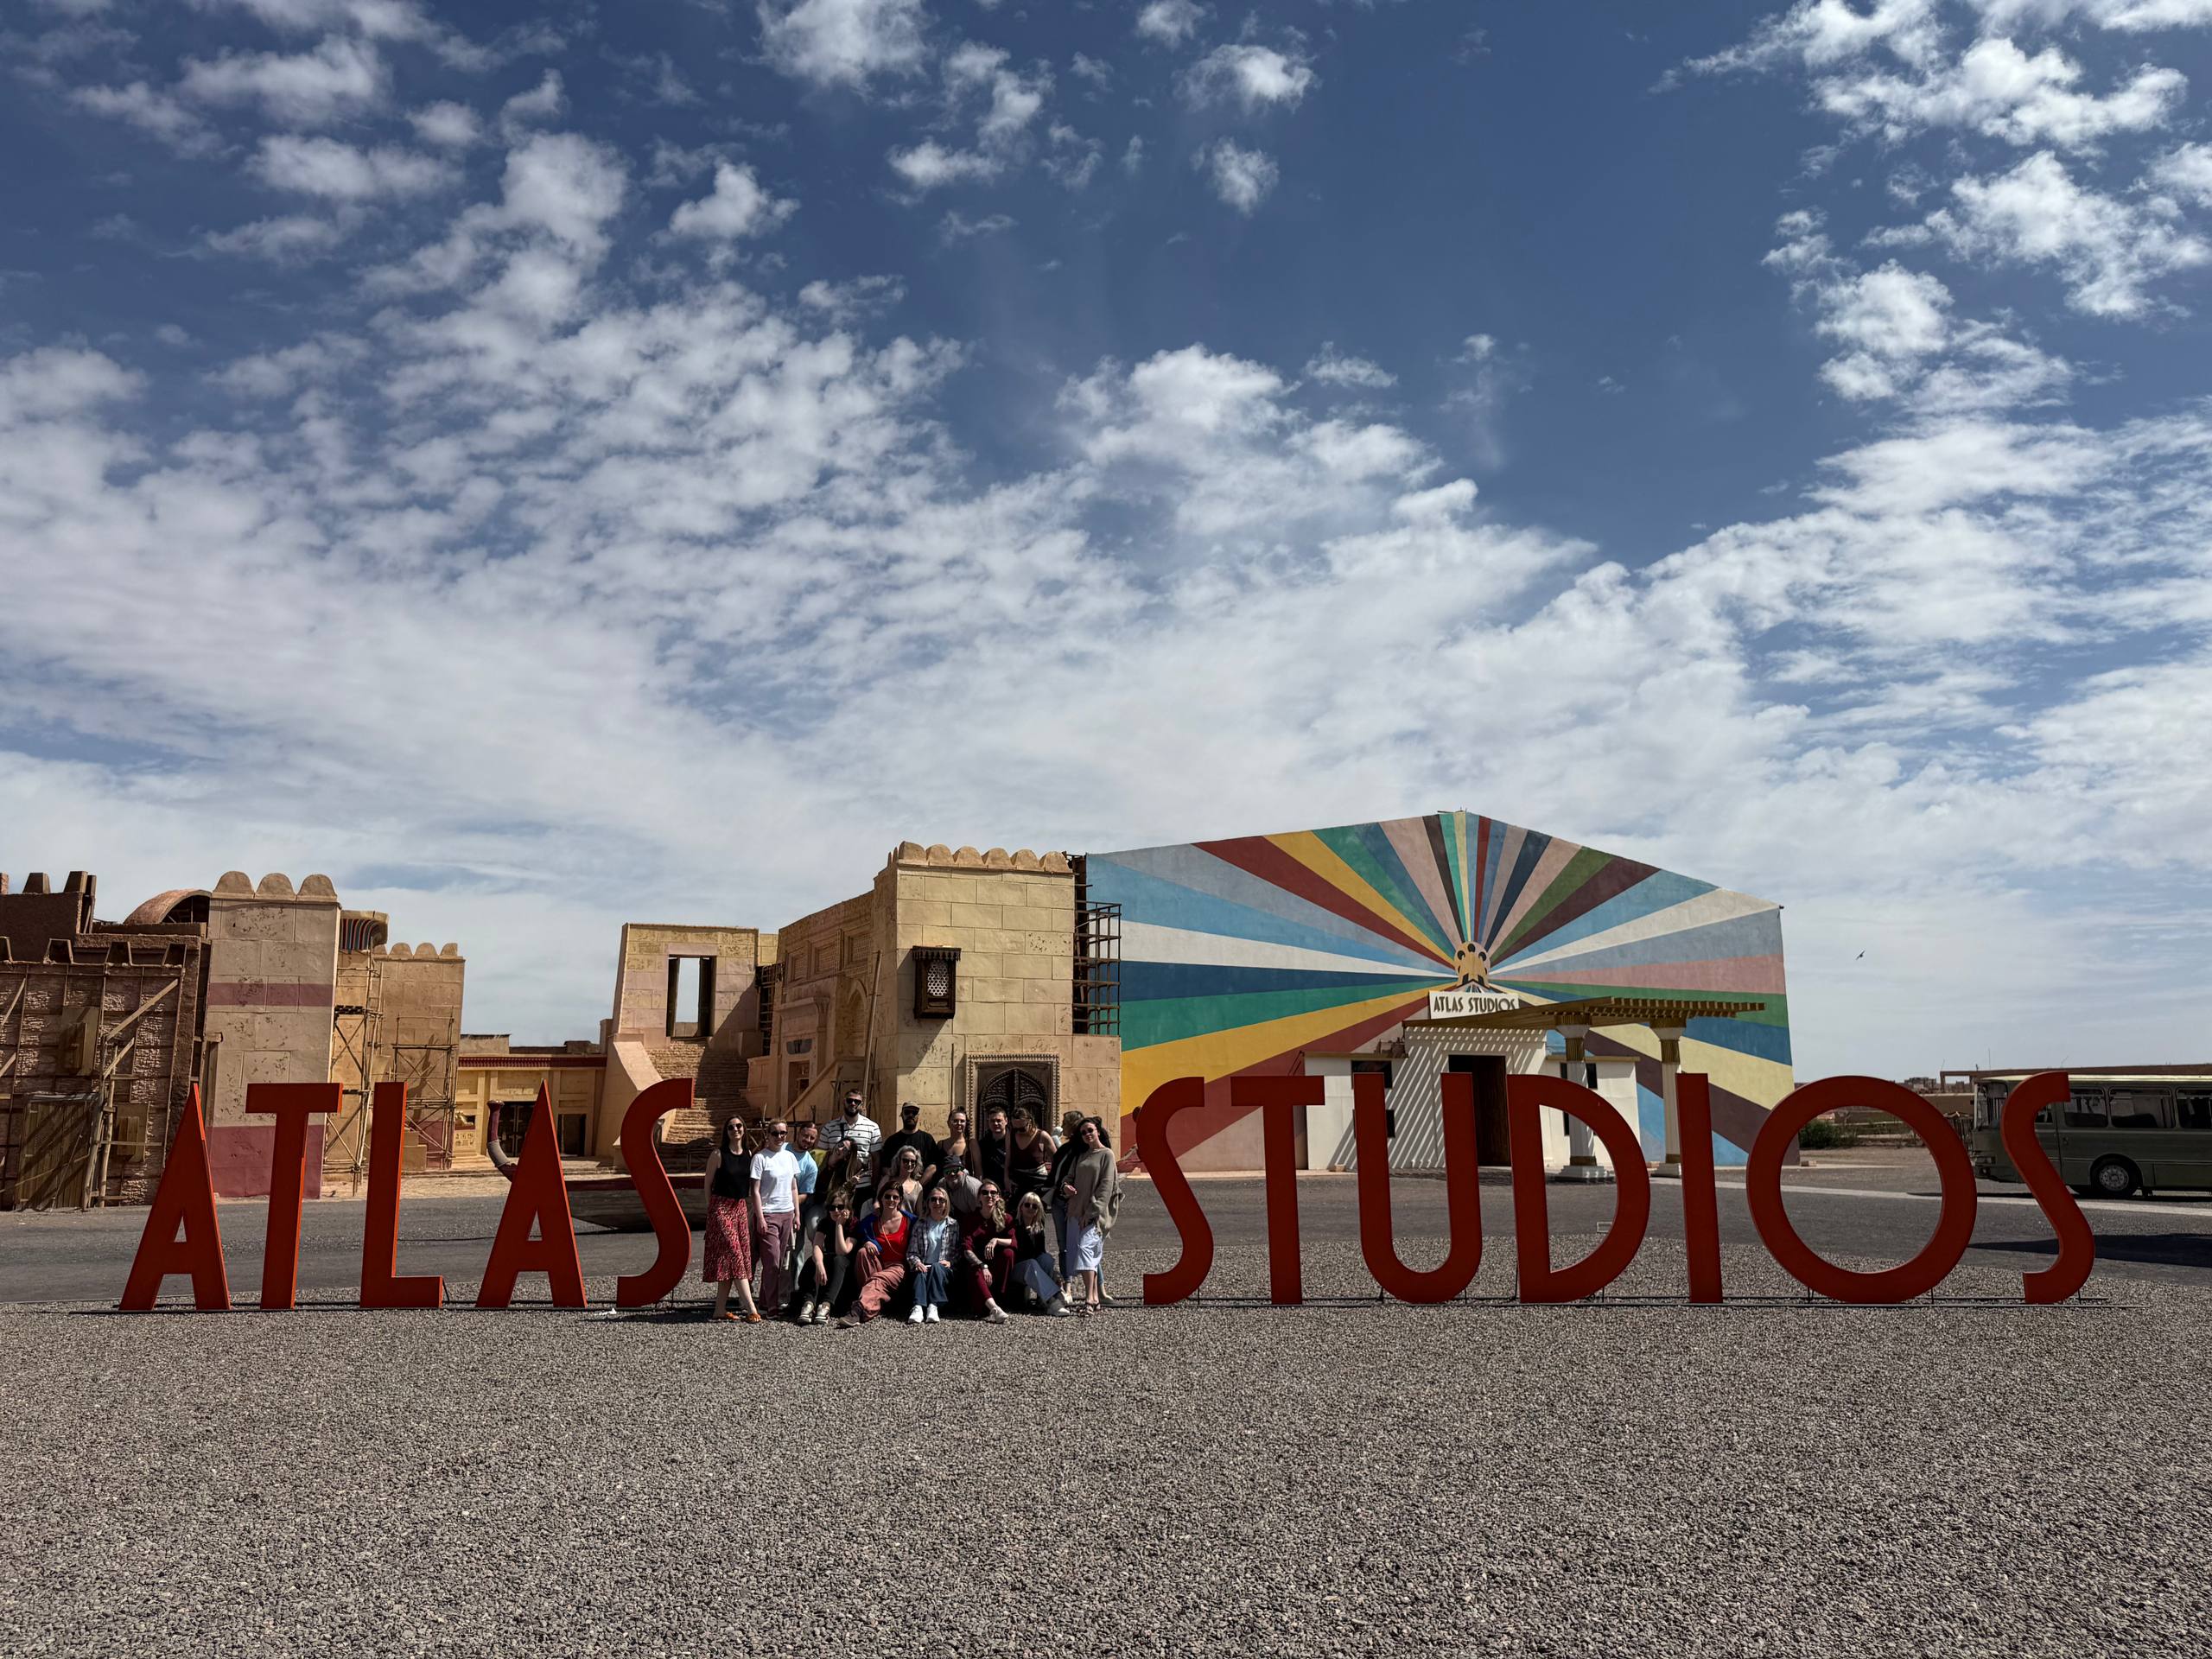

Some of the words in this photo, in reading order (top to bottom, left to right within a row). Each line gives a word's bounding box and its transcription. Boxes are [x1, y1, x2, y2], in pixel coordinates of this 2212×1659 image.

[1433, 996, 1464, 1012] ATLAS
[1469, 997, 1515, 1013] STUDIOS
[119, 1079, 694, 1309] ATLAS
[1136, 1071, 2095, 1305] STUDIOS
